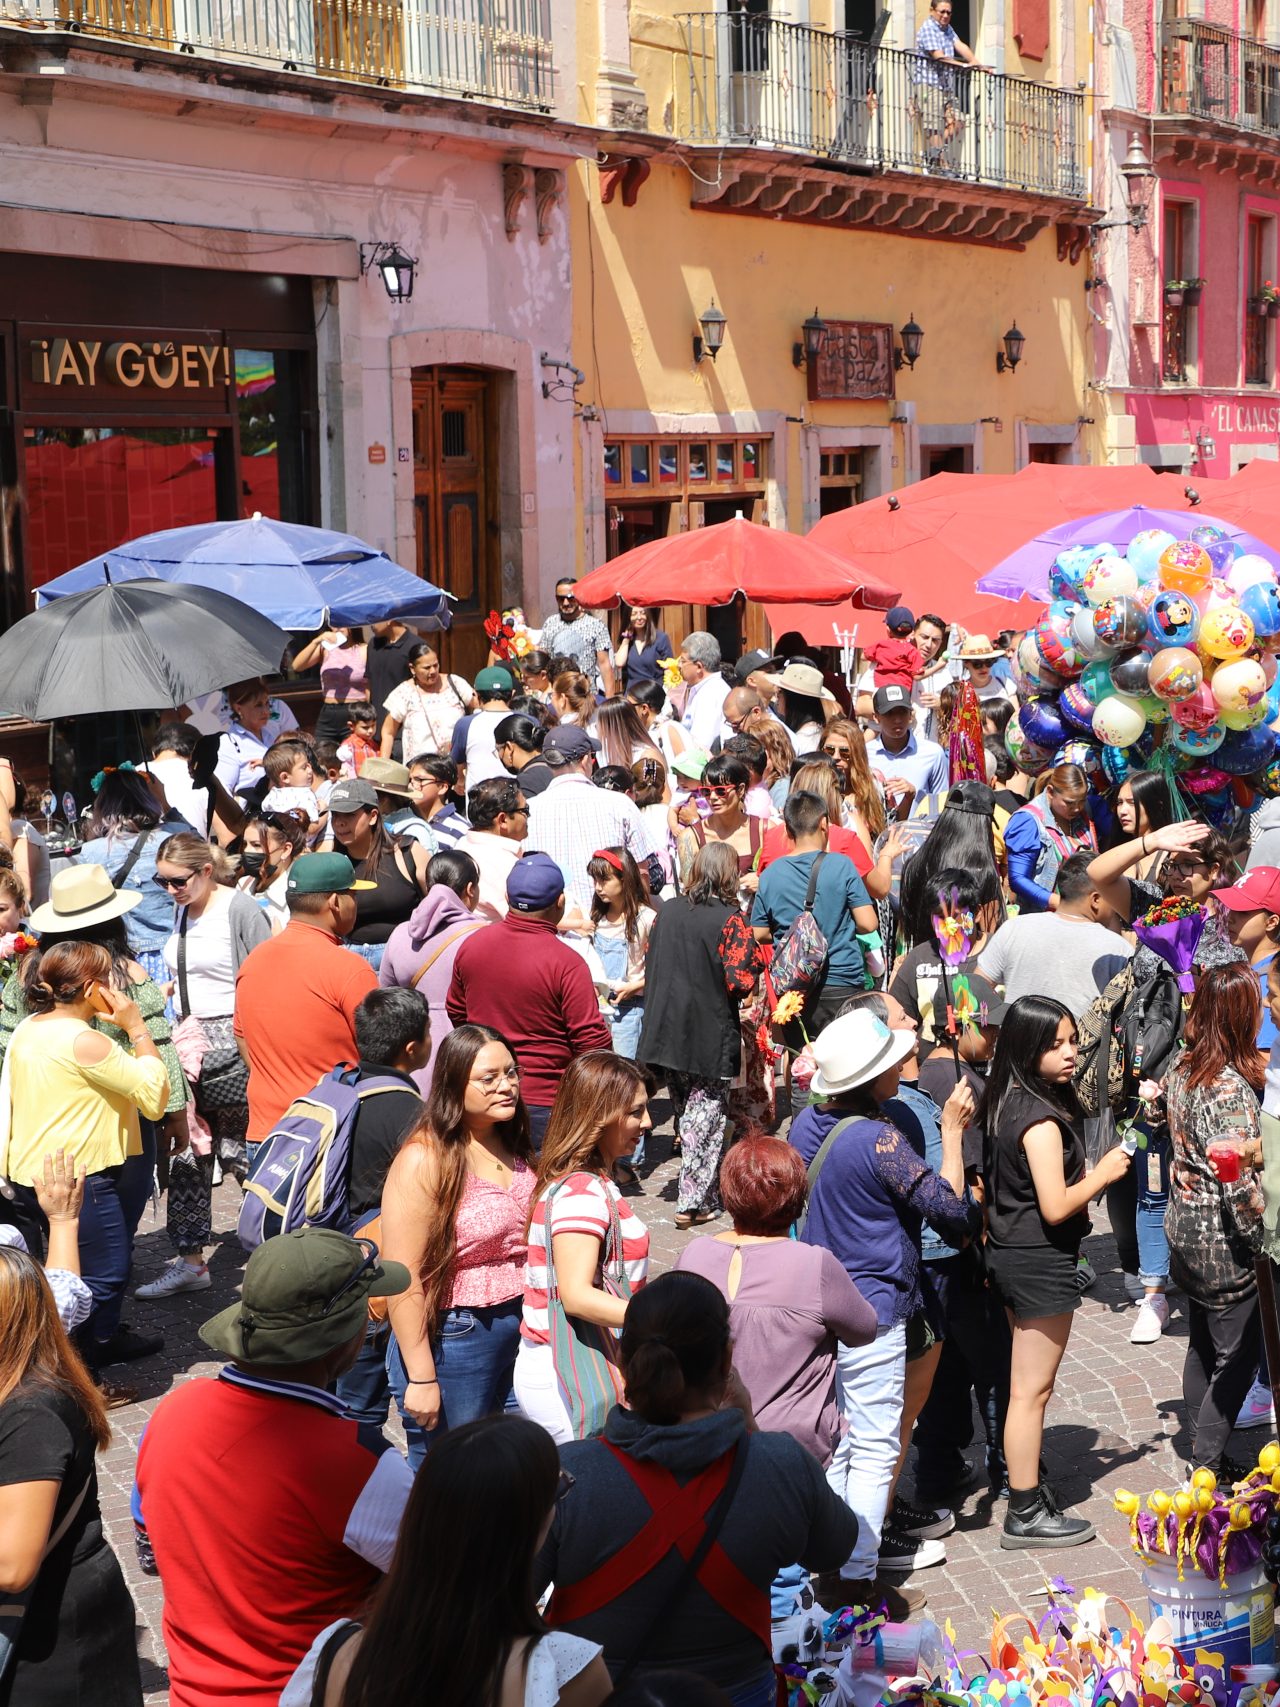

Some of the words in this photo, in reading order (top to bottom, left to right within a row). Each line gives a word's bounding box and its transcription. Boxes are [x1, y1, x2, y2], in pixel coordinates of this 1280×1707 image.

[41, 338, 102, 386] ¡AY
[115, 341, 231, 389] GÜEY!
[1133, 1045, 1144, 1067] LOVE
[1171, 1609, 1223, 1621] PINTURA
